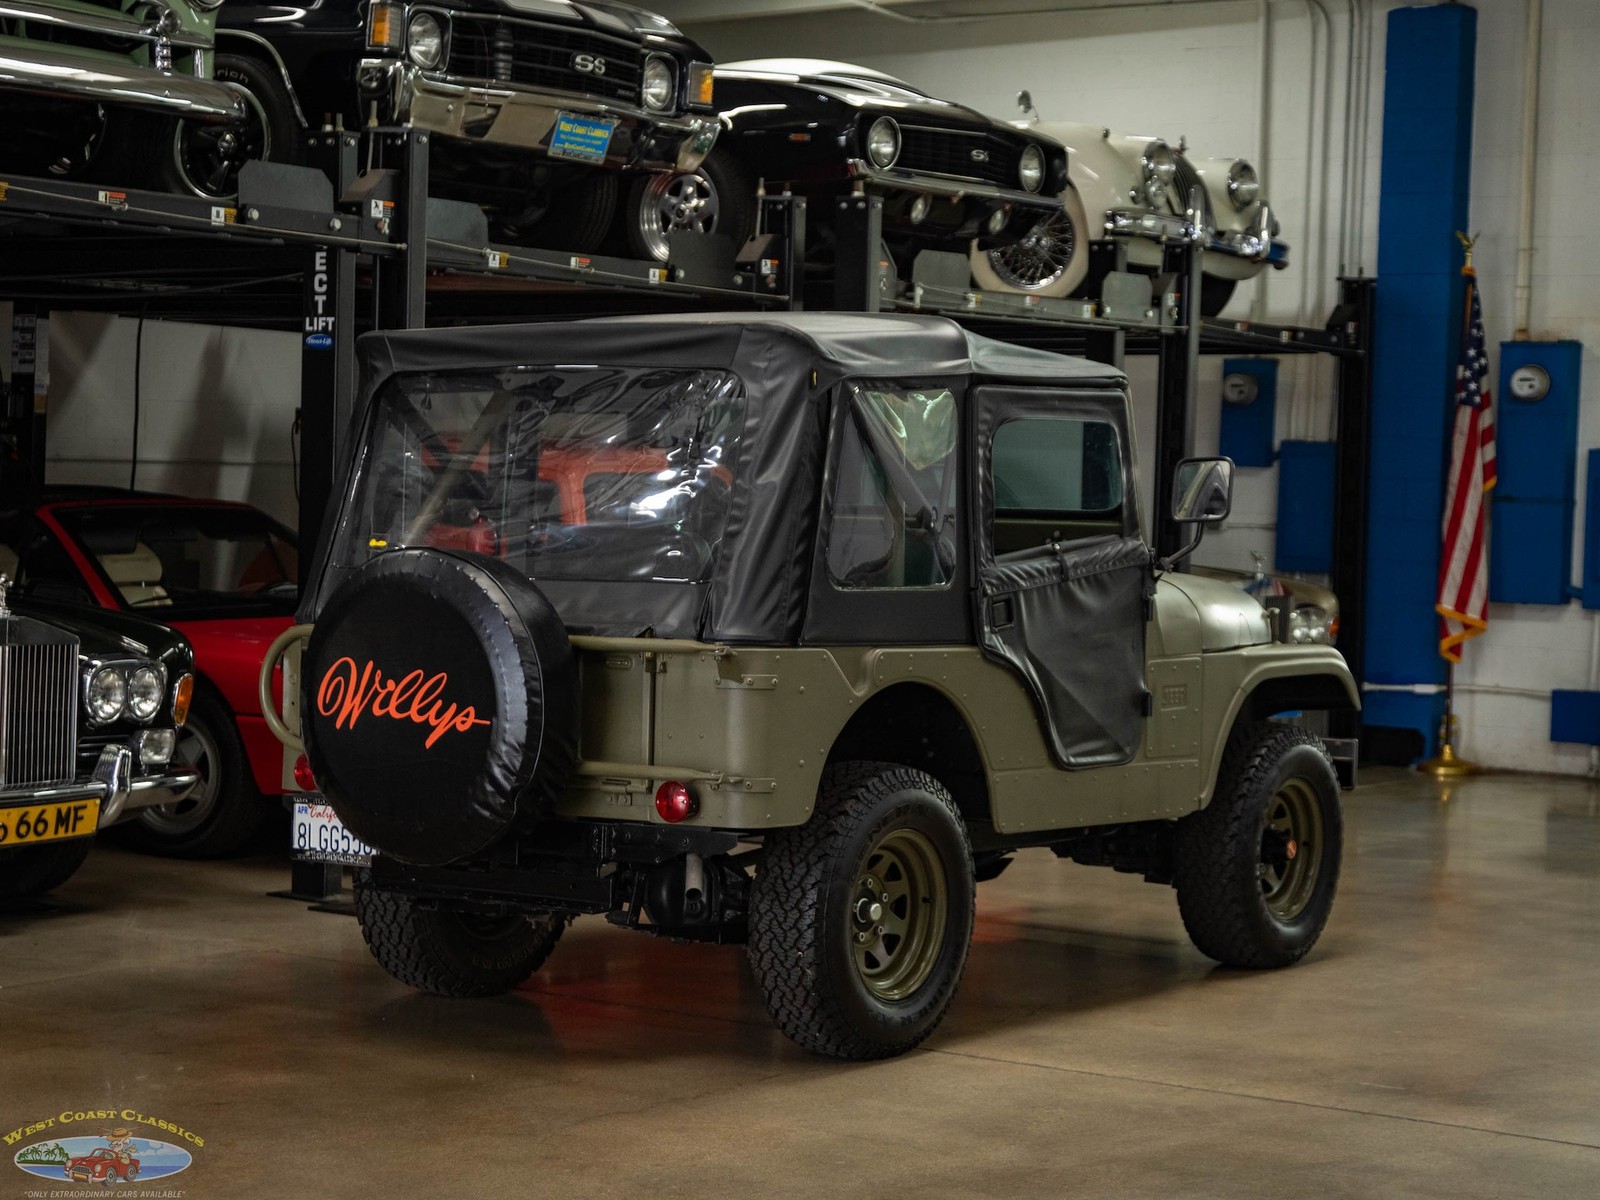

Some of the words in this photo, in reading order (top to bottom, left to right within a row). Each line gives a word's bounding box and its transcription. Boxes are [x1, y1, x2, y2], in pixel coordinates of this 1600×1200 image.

[574, 54, 606, 76] SS
[314, 246, 328, 315] ECT
[305, 317, 335, 332] LIFT
[317, 656, 491, 749] Willys
